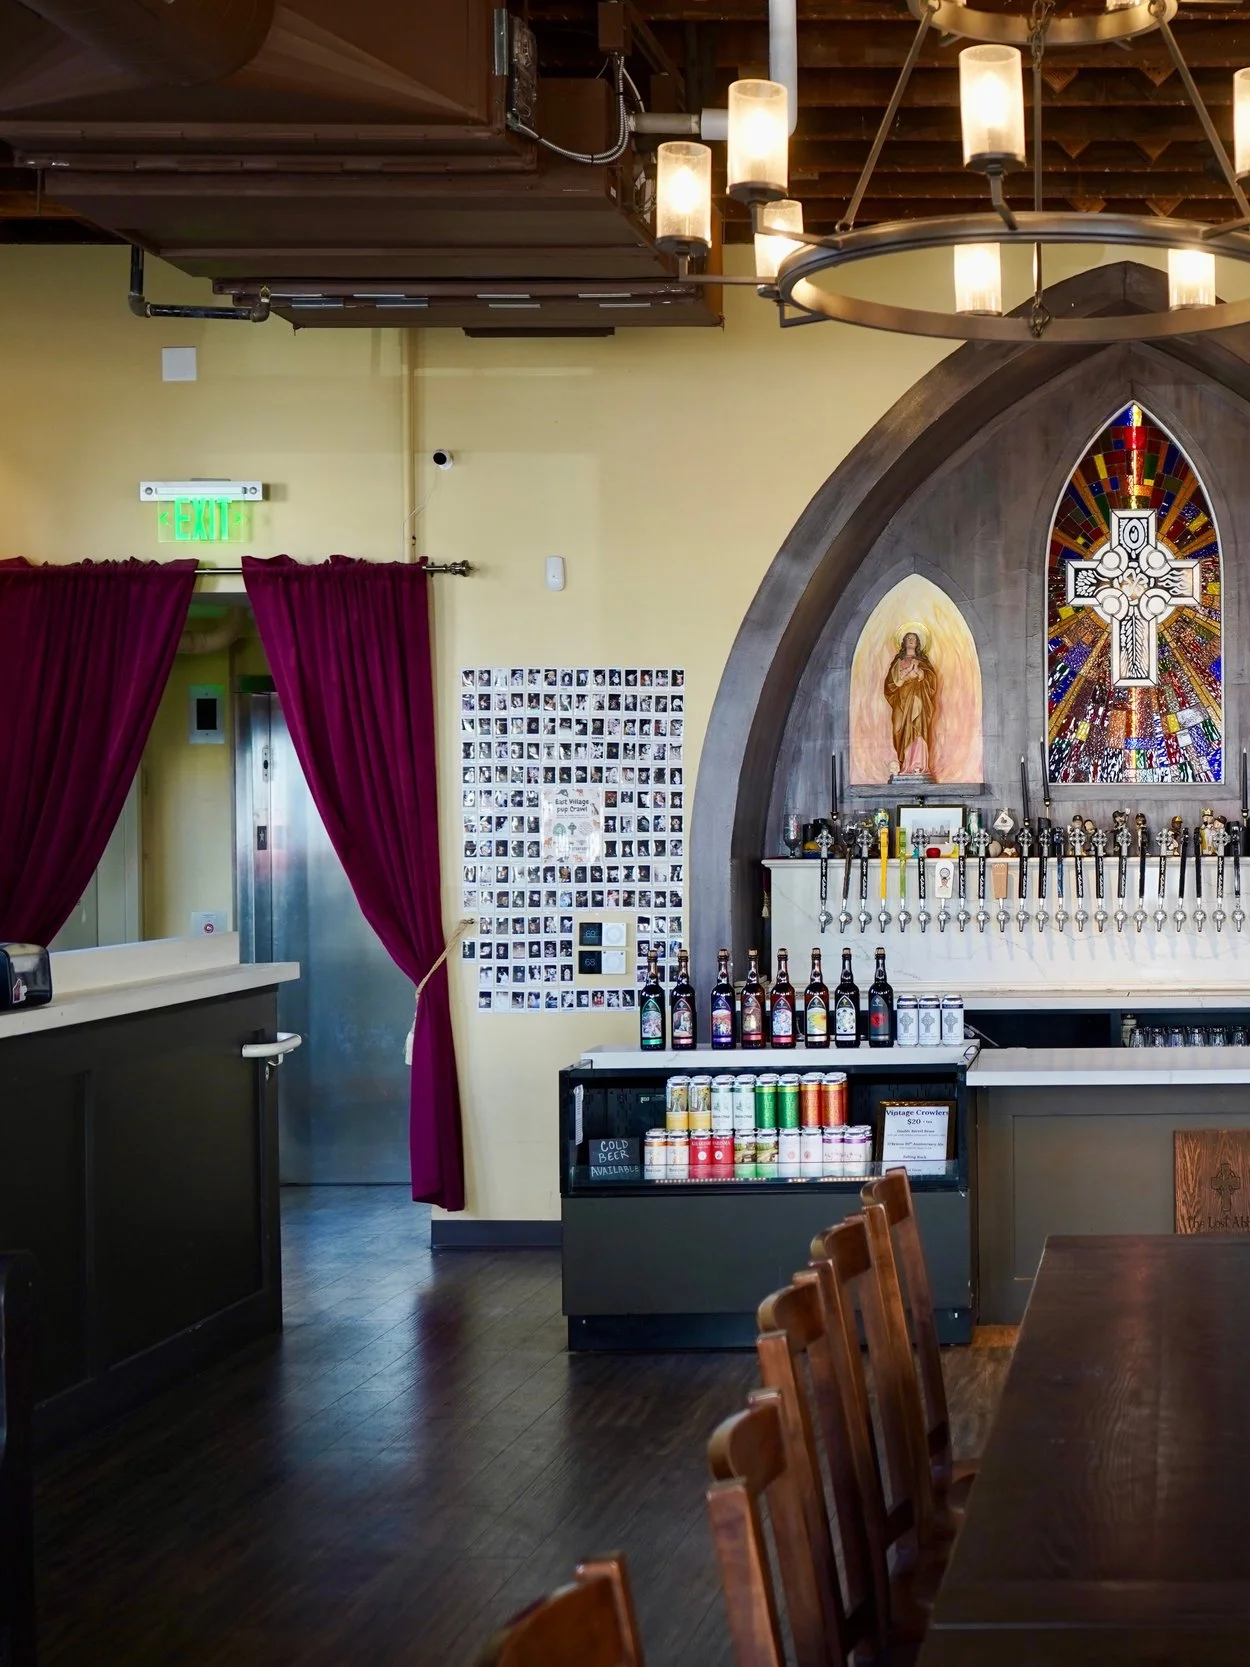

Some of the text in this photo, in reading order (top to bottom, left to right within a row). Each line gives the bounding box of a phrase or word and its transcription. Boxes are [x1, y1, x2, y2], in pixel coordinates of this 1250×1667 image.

[174, 495, 232, 541] EXIT
[568, 798, 590, 806] Village
[585, 929, 596, 938] 69
[584, 958, 596, 966] 68
[886, 1109, 915, 1117] Vintage
[600, 1139, 629, 1152] COLD
[598, 1149, 630, 1164] BEER
[590, 1165, 640, 1178] AVAILABLE
[1187, 1215, 1205, 1228] The
[1208, 1215, 1230, 1229] Lost
